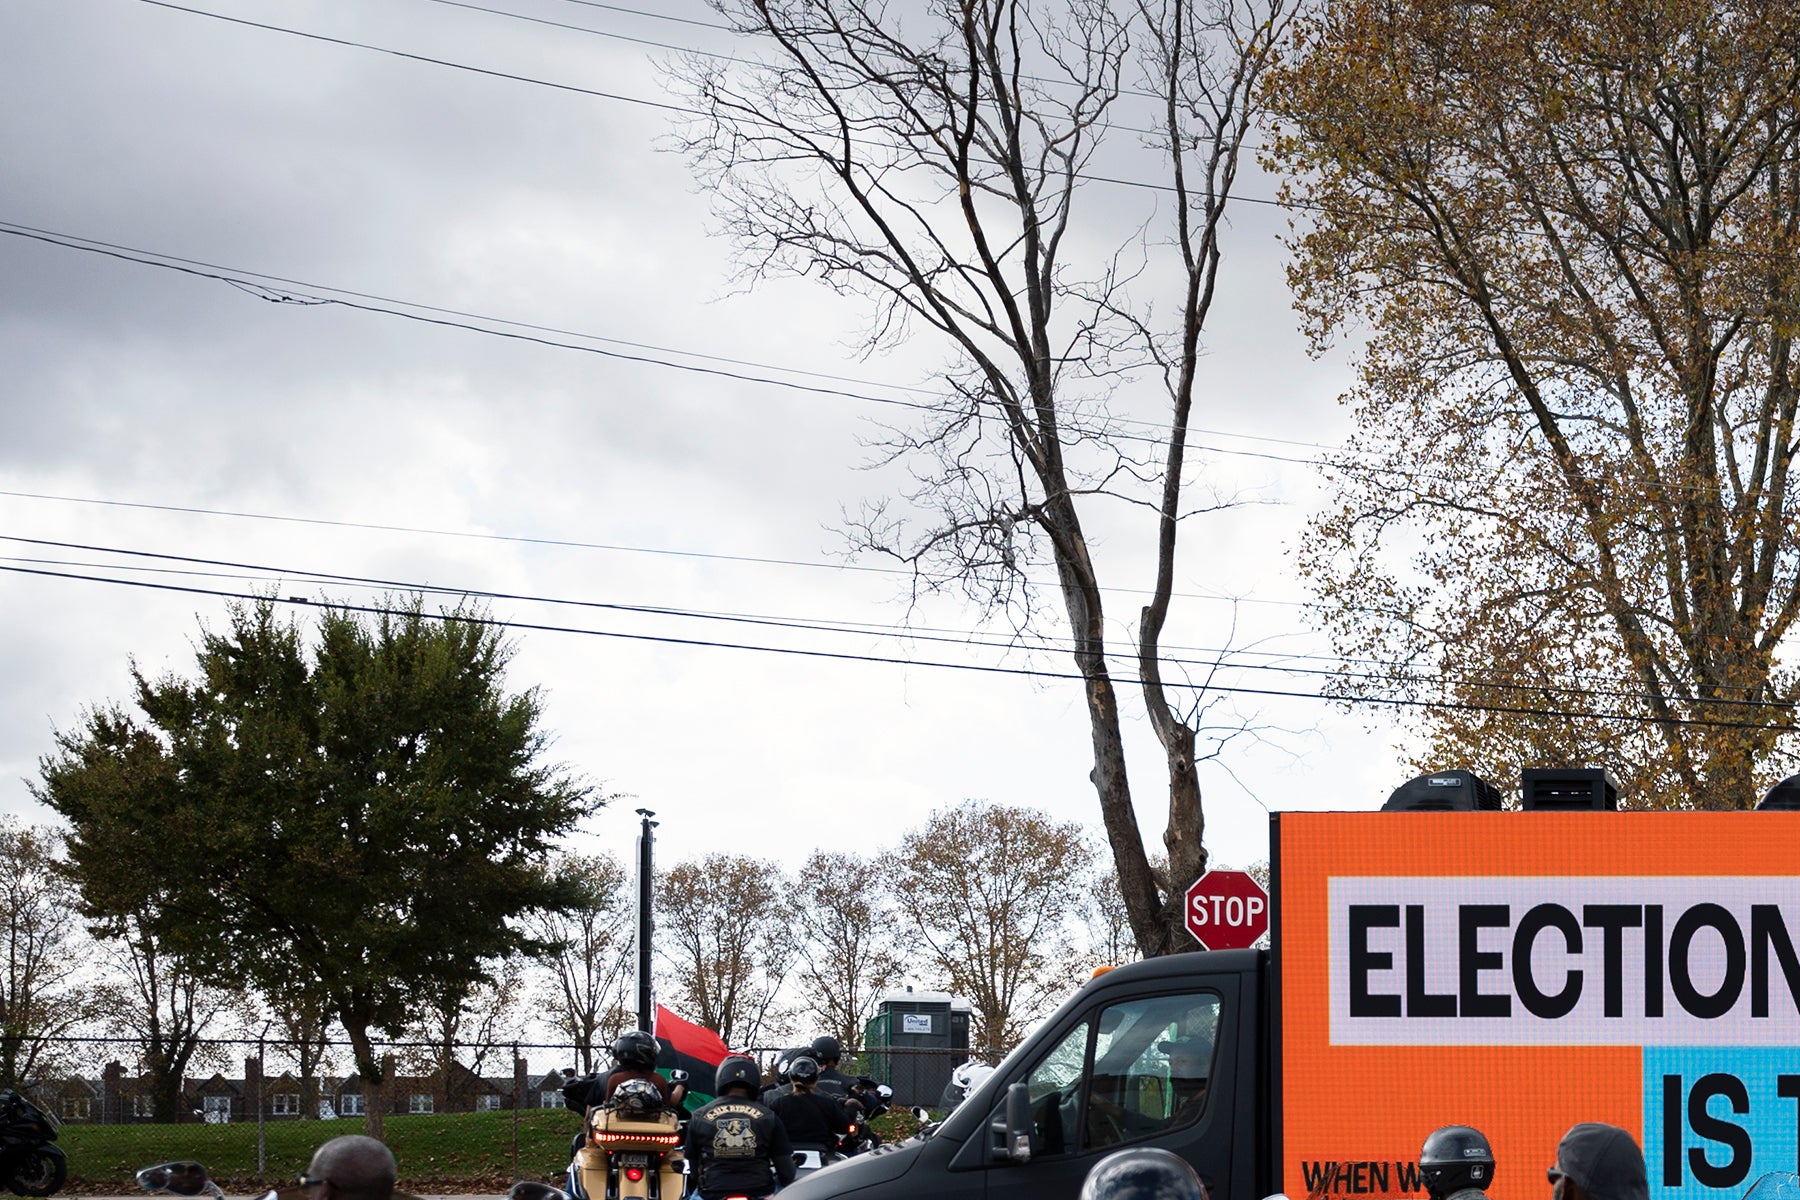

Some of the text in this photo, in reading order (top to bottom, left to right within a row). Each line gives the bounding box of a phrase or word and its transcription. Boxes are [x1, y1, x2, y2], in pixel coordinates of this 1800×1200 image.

[1191, 895, 1264, 927] STOP
[1663, 1074, 1752, 1188] IS
[1302, 1161, 1424, 1194] WHEN W
